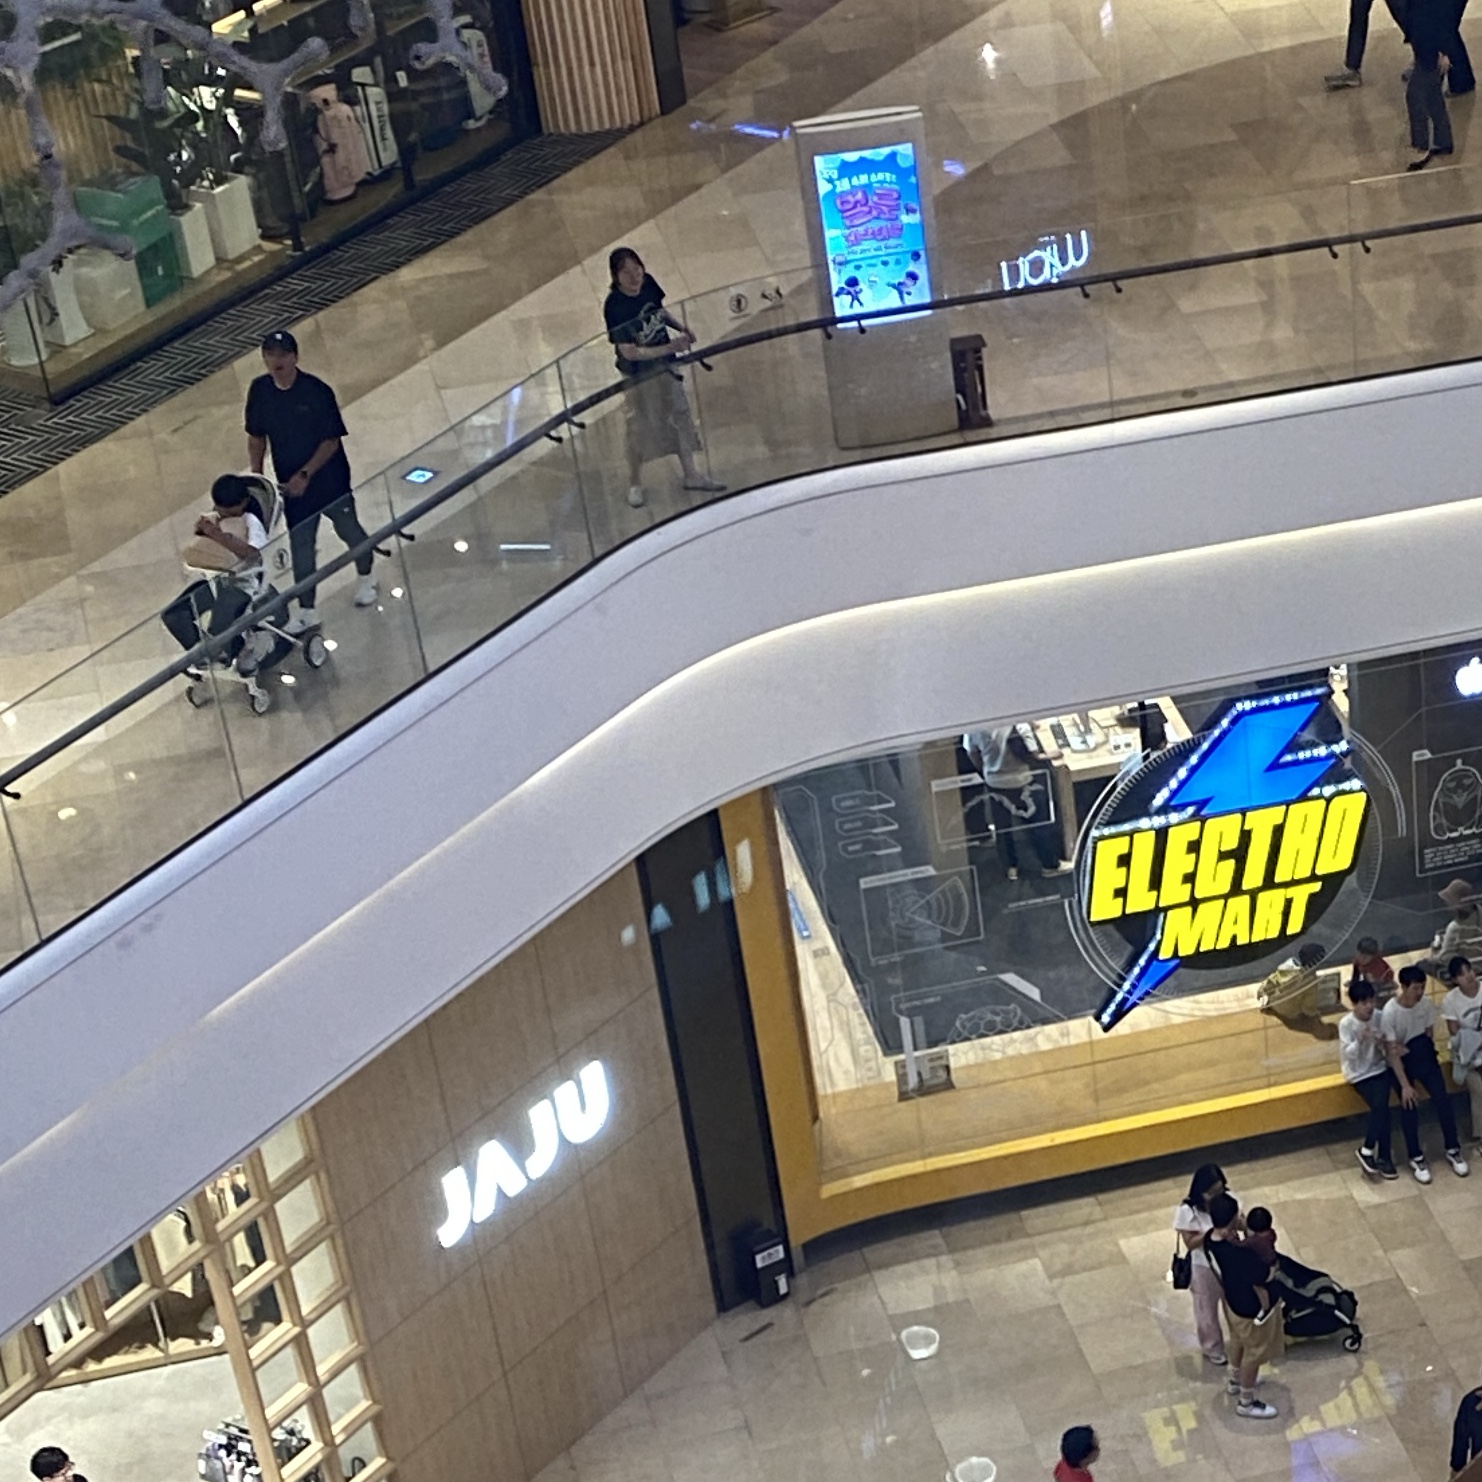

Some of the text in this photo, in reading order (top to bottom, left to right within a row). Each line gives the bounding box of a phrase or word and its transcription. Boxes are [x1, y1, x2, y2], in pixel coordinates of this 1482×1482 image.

[1090, 791, 1368, 922] ELECTRO
[1158, 882, 1323, 960] MART
[436, 1060, 610, 1248] JAJU
